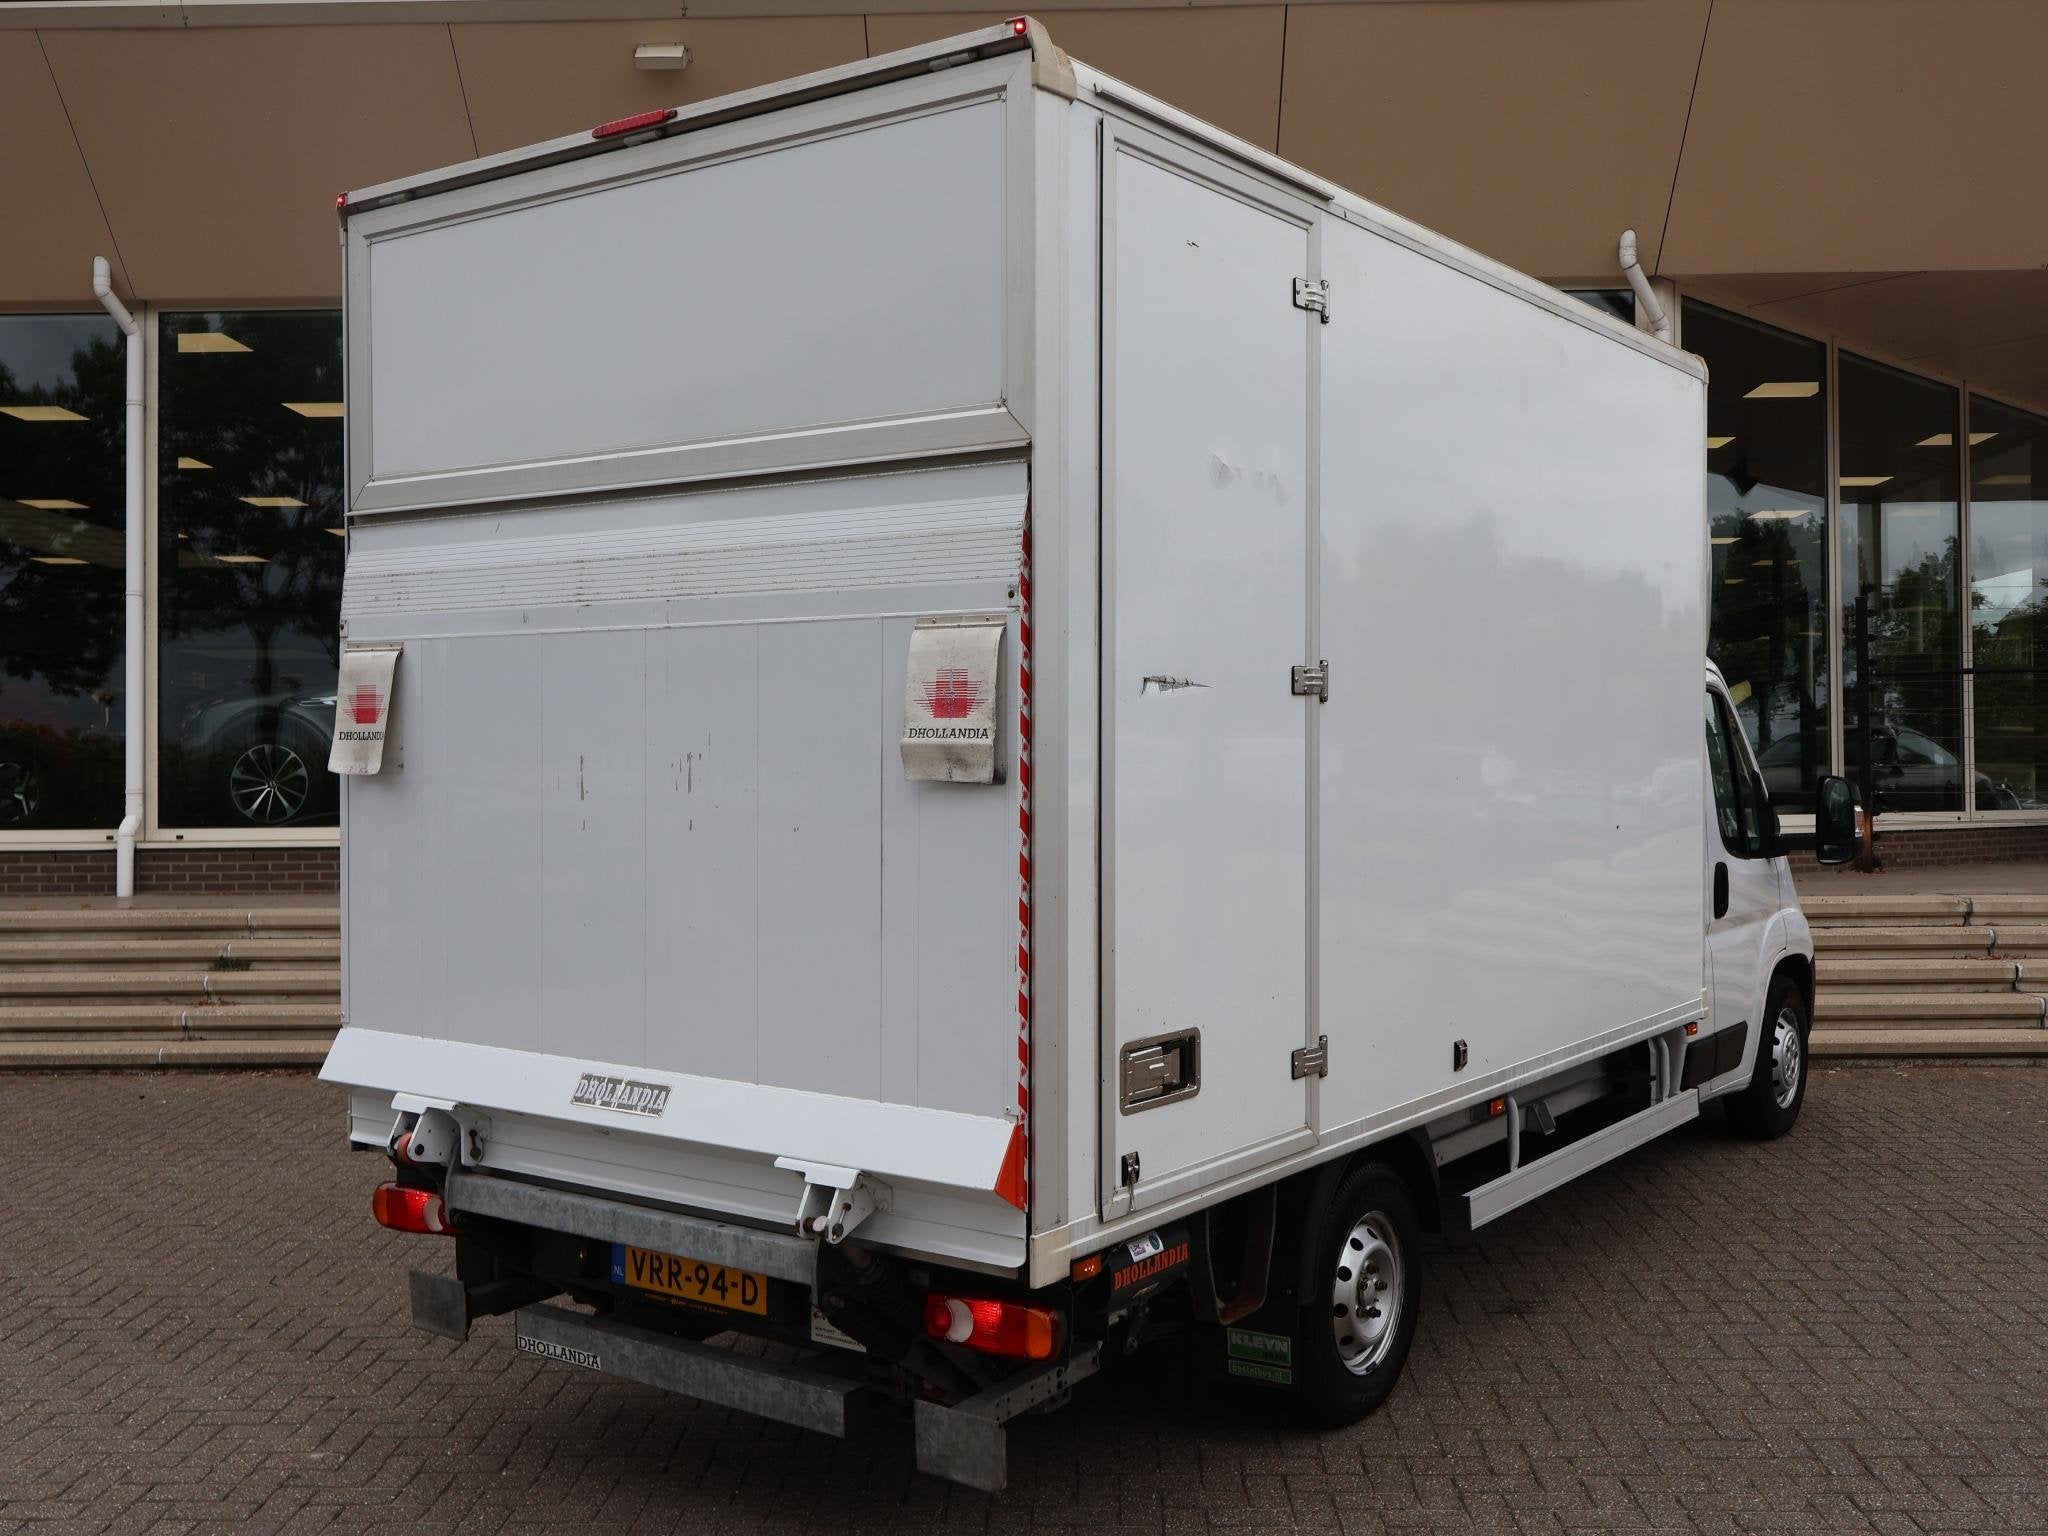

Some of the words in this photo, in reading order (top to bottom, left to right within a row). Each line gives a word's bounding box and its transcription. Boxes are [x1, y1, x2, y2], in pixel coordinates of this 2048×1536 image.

[908, 728, 989, 739] DHOLLANDIA
[575, 1078, 667, 1110] DHOLLANDIA
[613, 1264, 625, 1276] NL
[631, 1249, 759, 1306] VRR-94-D
[1113, 1241, 1190, 1290] DHOLLANDIA
[517, 1336, 601, 1368] DHOLLANDIA
